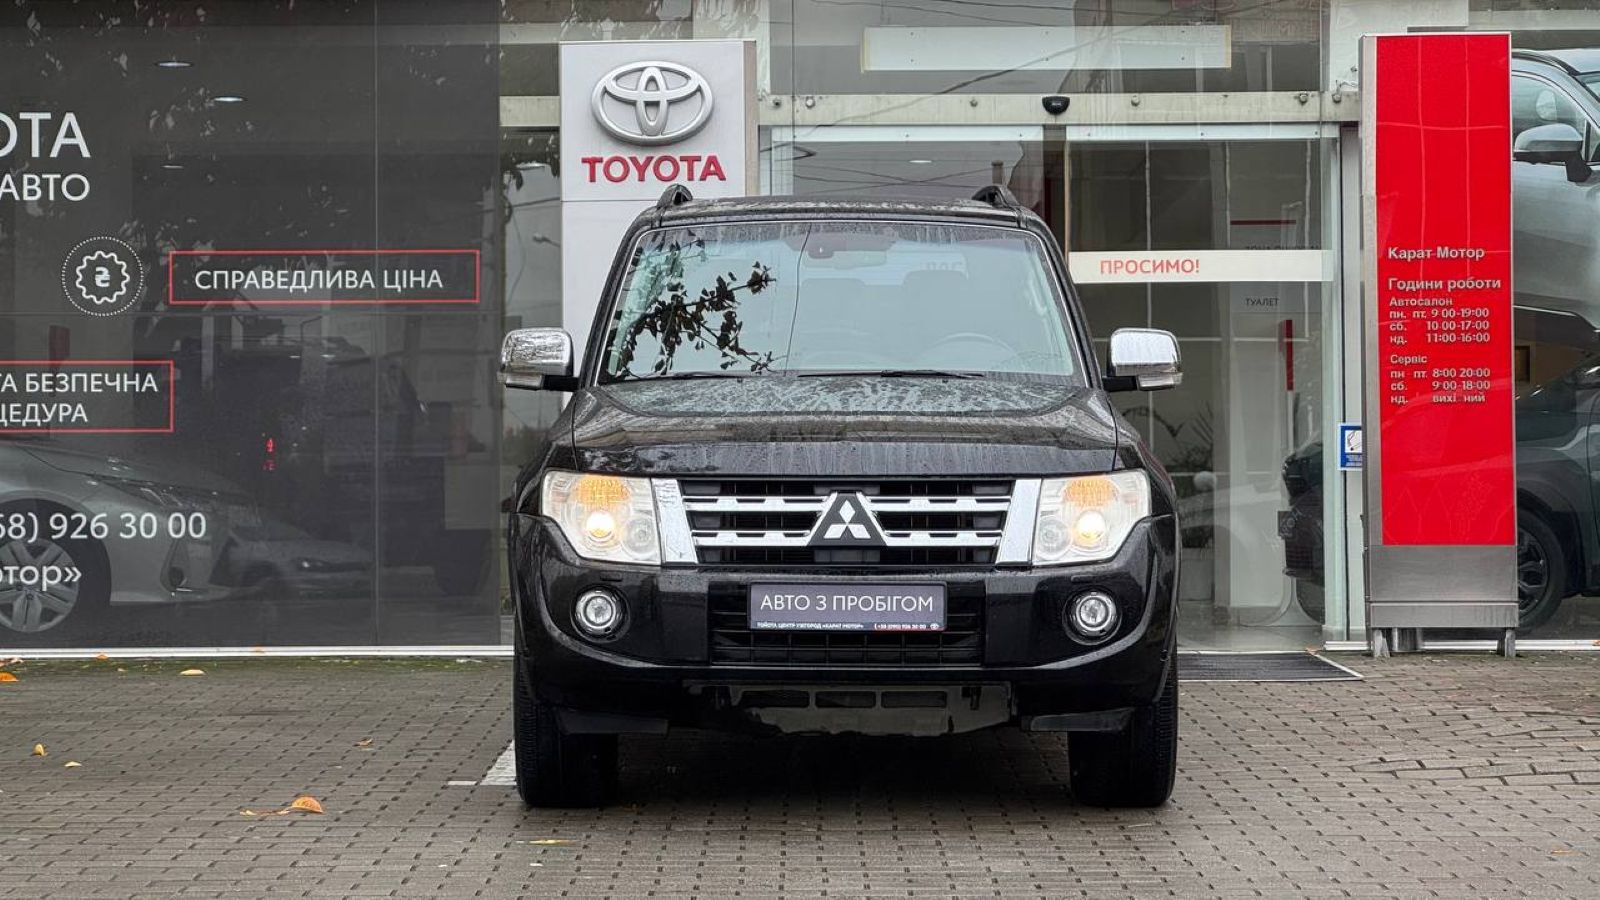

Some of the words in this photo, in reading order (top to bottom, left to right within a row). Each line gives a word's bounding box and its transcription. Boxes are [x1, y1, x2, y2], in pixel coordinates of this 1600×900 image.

[581, 155, 726, 183] TOYOTA
[0, 172, 91, 201] АВТО
[1388, 246, 1433, 262] Карат
[1436, 246, 1485, 261] Мотор
[1100, 258, 1200, 275] ПРОСИМО!
[194, 269, 375, 292] СПРАВЕДЛИВА
[383, 269, 443, 292] ЦІНА
[1388, 277, 1443, 292] Години
[1447, 275, 1501, 292] роботи
[1245, 298, 1279, 307] ТУАЛЕТ
[1389, 297, 1453, 307] Автосалон
[1390, 354, 1427, 365] Сервіс
[25, 372, 158, 393] БЕЗПЕЧНА
[50, 511, 109, 539] 926
[119, 511, 158, 539] 30
[167, 511, 207, 539] 00
[0, 564, 82, 592] тор»
[760, 594, 811, 611] АВТО
[832, 595, 934, 612] ПРОБІГОМ
